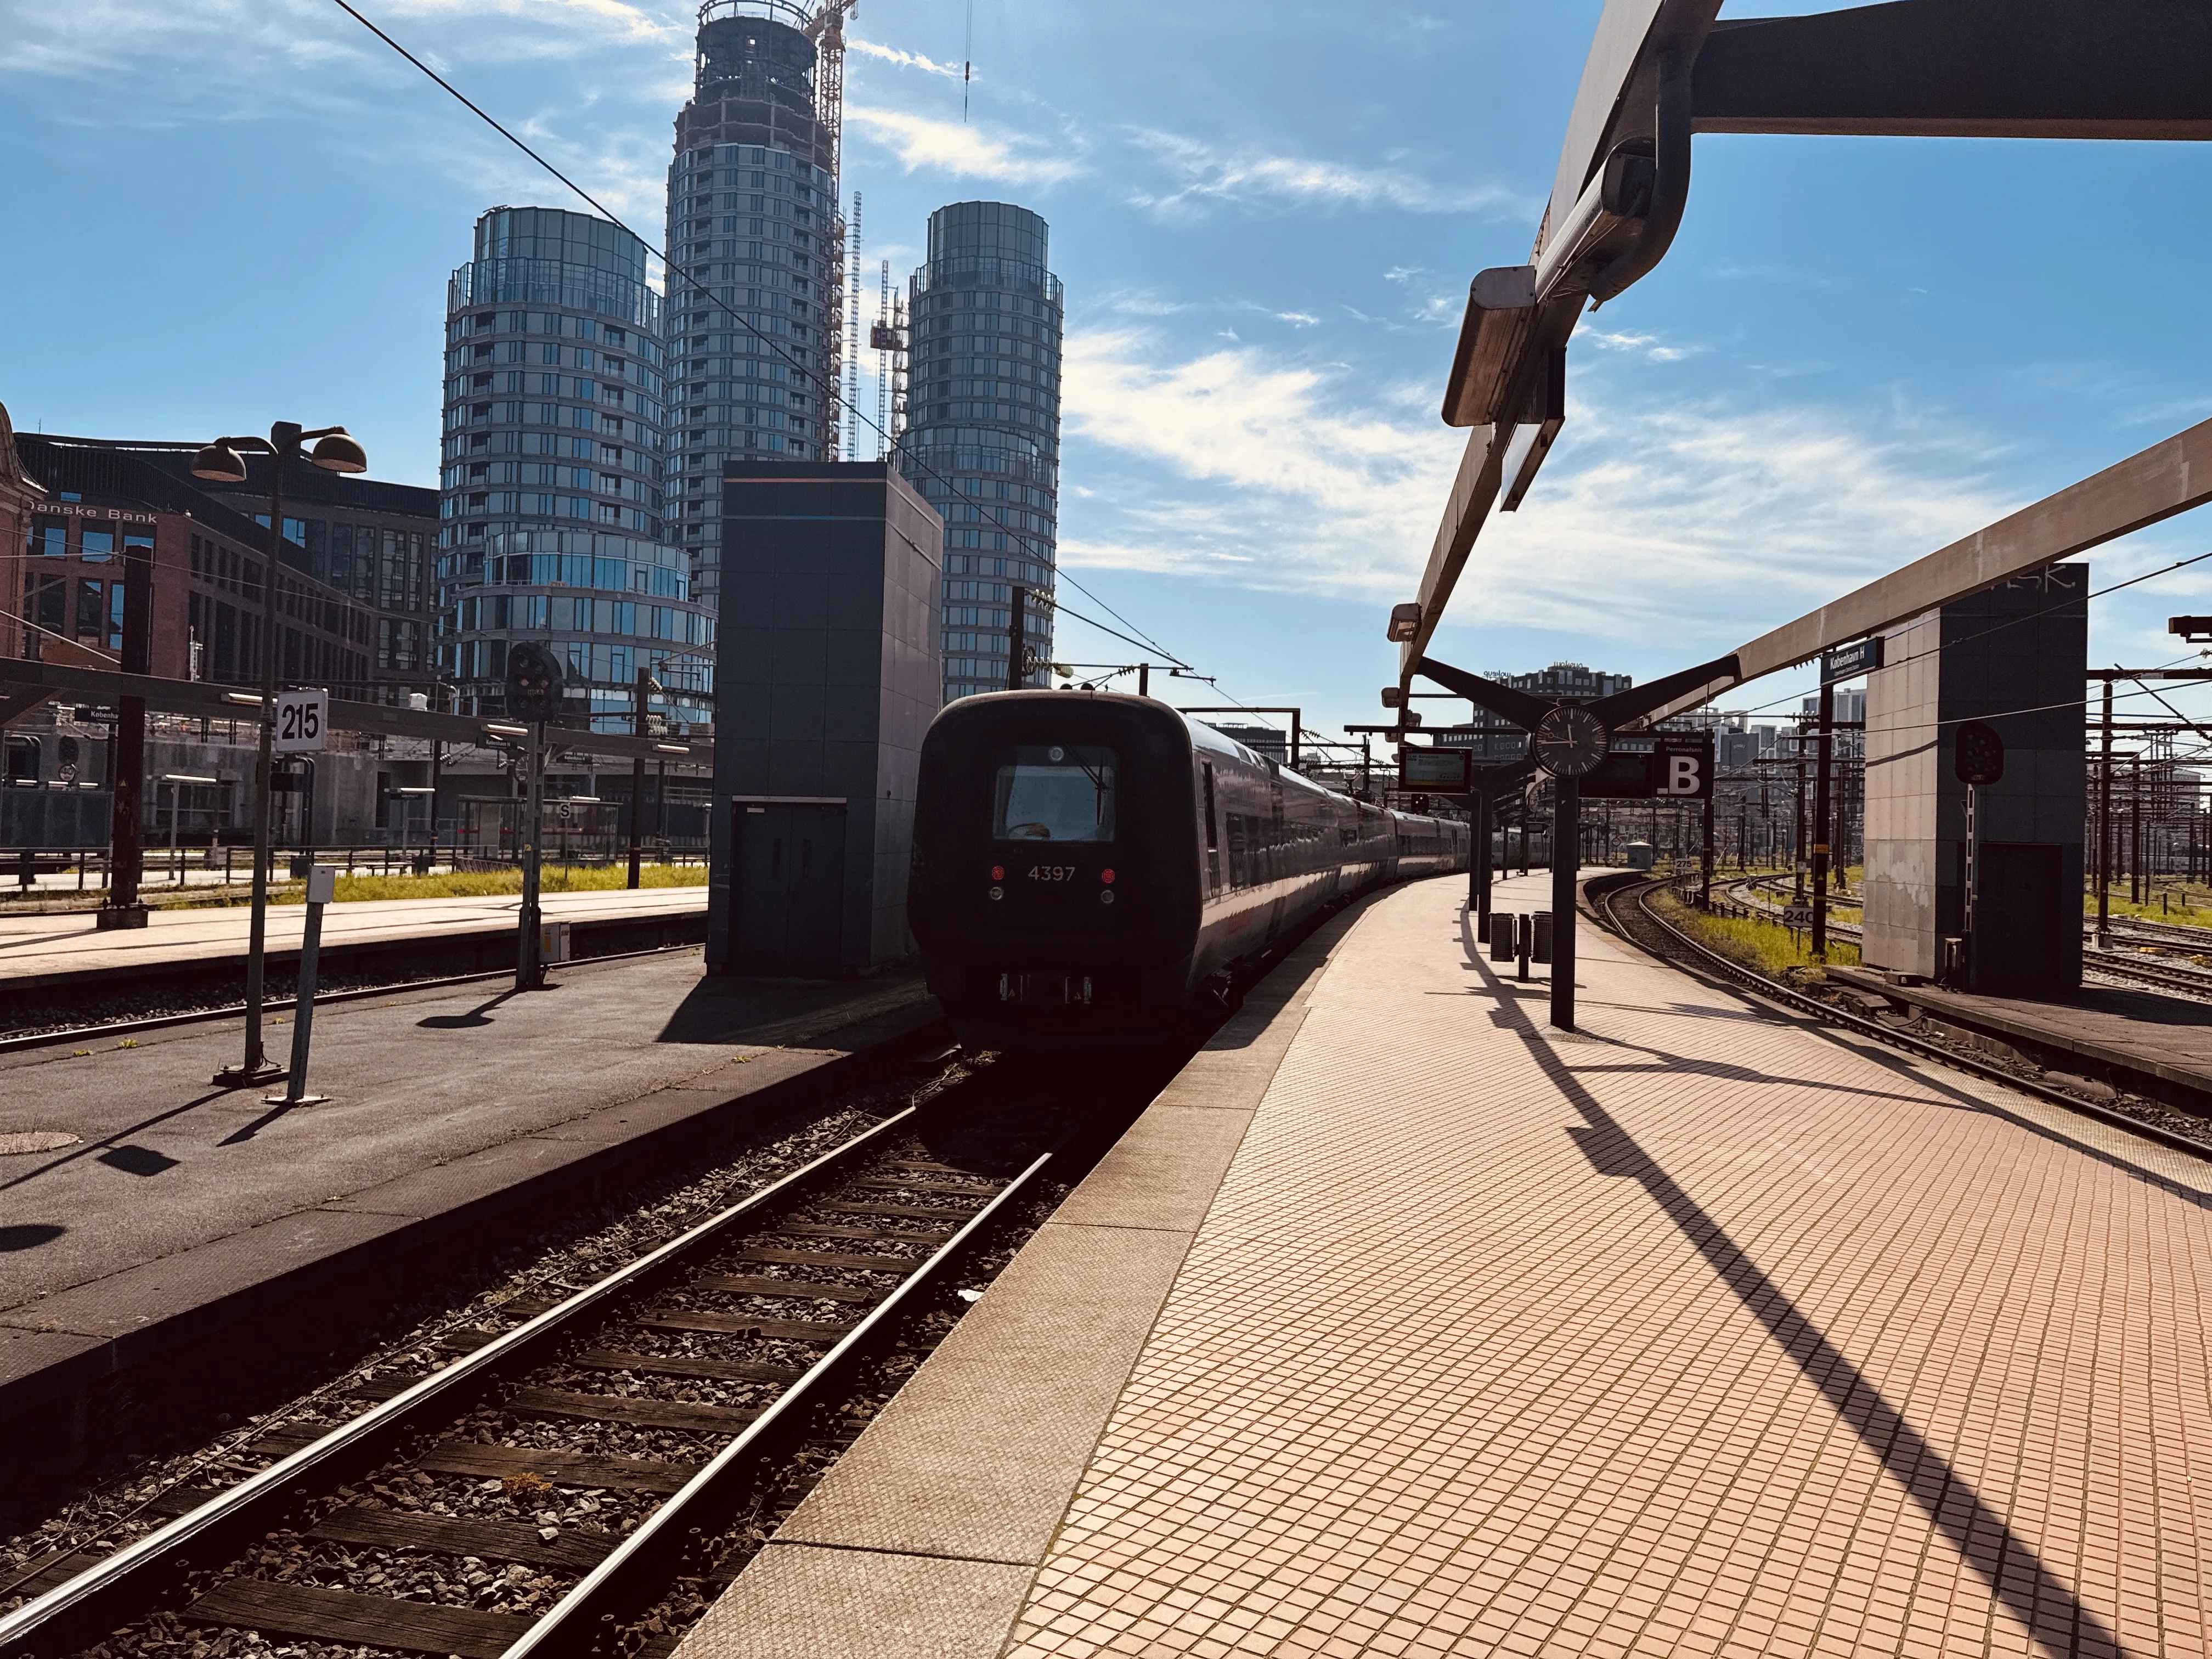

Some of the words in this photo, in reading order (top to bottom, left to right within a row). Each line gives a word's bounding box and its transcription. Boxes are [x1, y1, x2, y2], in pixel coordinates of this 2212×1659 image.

[108, 509, 157, 524] Bank
[1830, 651, 1859, 670] København
[1859, 645, 1866, 660] H
[281, 703, 319, 740] 215
[1669, 755, 1701, 794] B
[561, 805, 569, 817] S
[1028, 866, 1076, 881] 4397
[1784, 910, 1813, 924] 240
